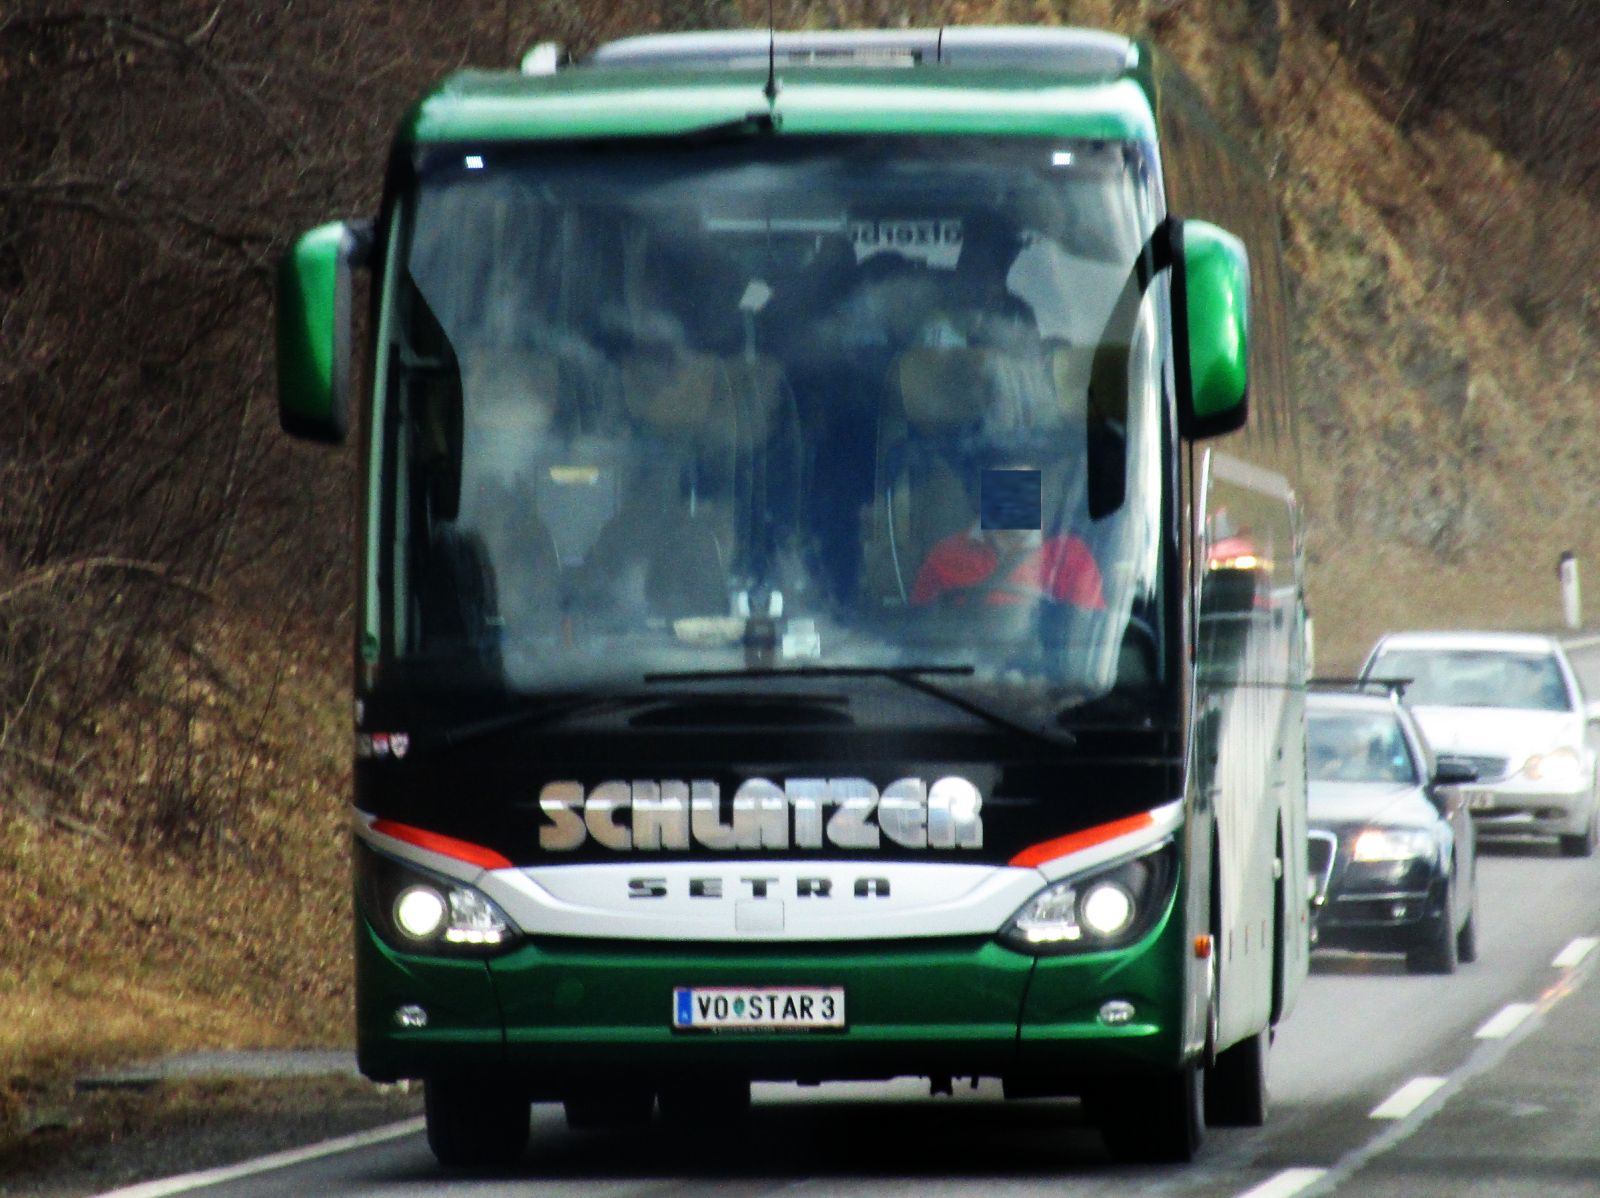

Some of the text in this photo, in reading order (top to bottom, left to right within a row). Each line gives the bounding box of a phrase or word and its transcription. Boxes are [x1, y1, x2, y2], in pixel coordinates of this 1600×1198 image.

[538, 777, 985, 851] SCHLATZER
[627, 877, 892, 899] SETRA
[697, 995, 728, 1020] VO
